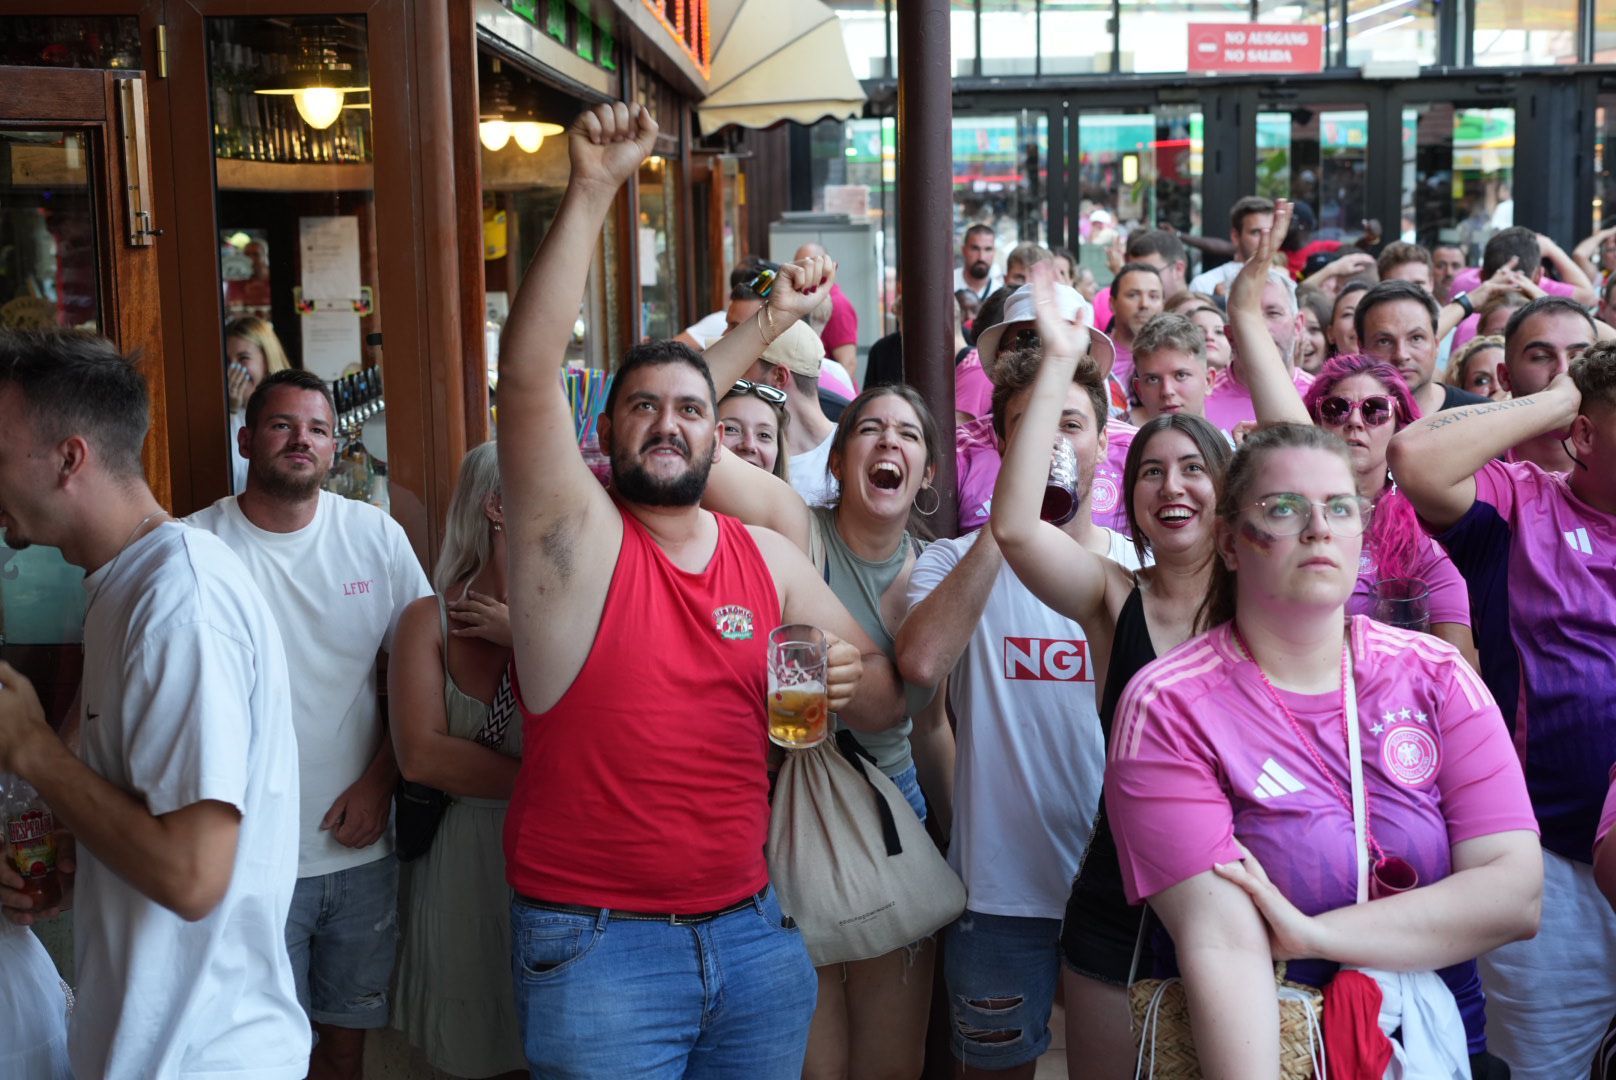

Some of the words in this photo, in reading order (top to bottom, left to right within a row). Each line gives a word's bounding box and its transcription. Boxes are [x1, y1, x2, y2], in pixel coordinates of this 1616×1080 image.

[1224, 31, 1245, 45] NO
[1247, 31, 1308, 46] AUSGANG
[1224, 49, 1245, 62] NO
[1246, 49, 1292, 63] SALIDA
